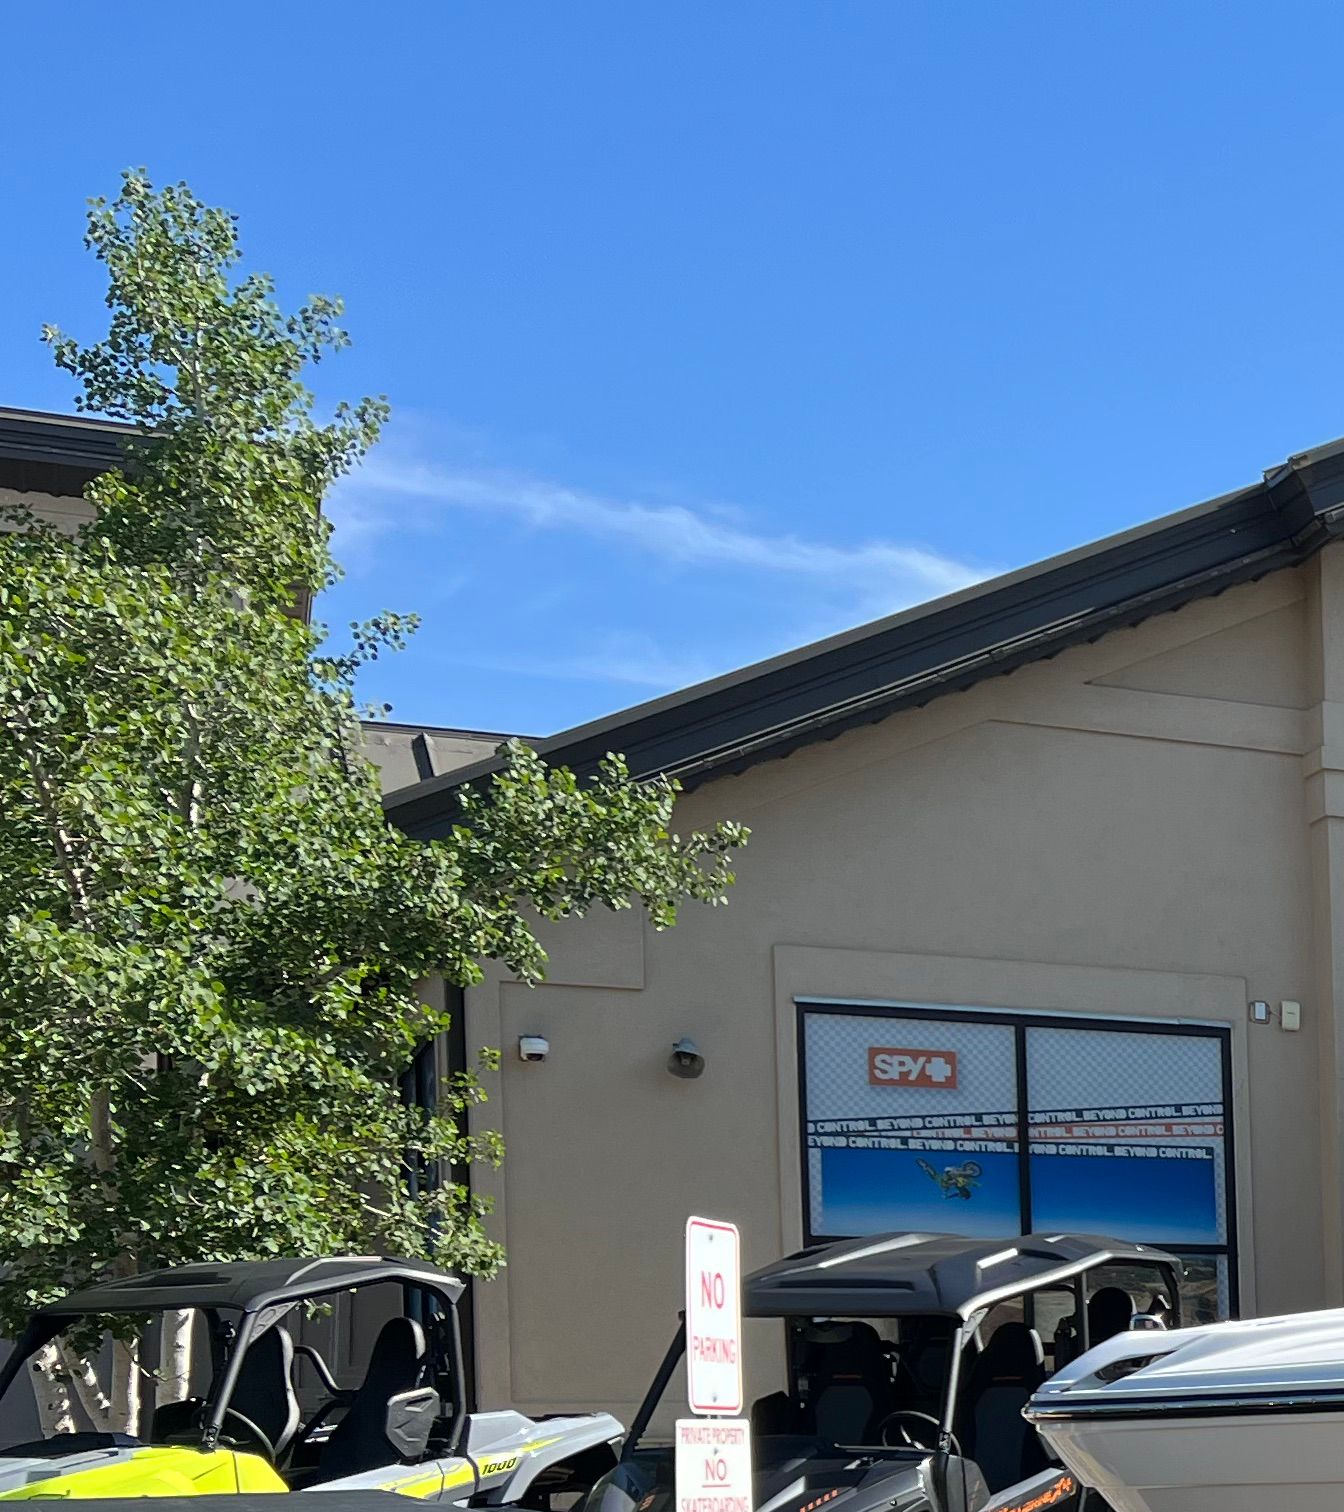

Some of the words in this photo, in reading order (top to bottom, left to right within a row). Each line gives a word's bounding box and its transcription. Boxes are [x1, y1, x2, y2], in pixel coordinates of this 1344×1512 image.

[701, 1270, 725, 1310] NO
[693, 1335, 737, 1365] PARKING
[482, 1456, 518, 1476] 1000
[705, 1458, 728, 1482] NO
